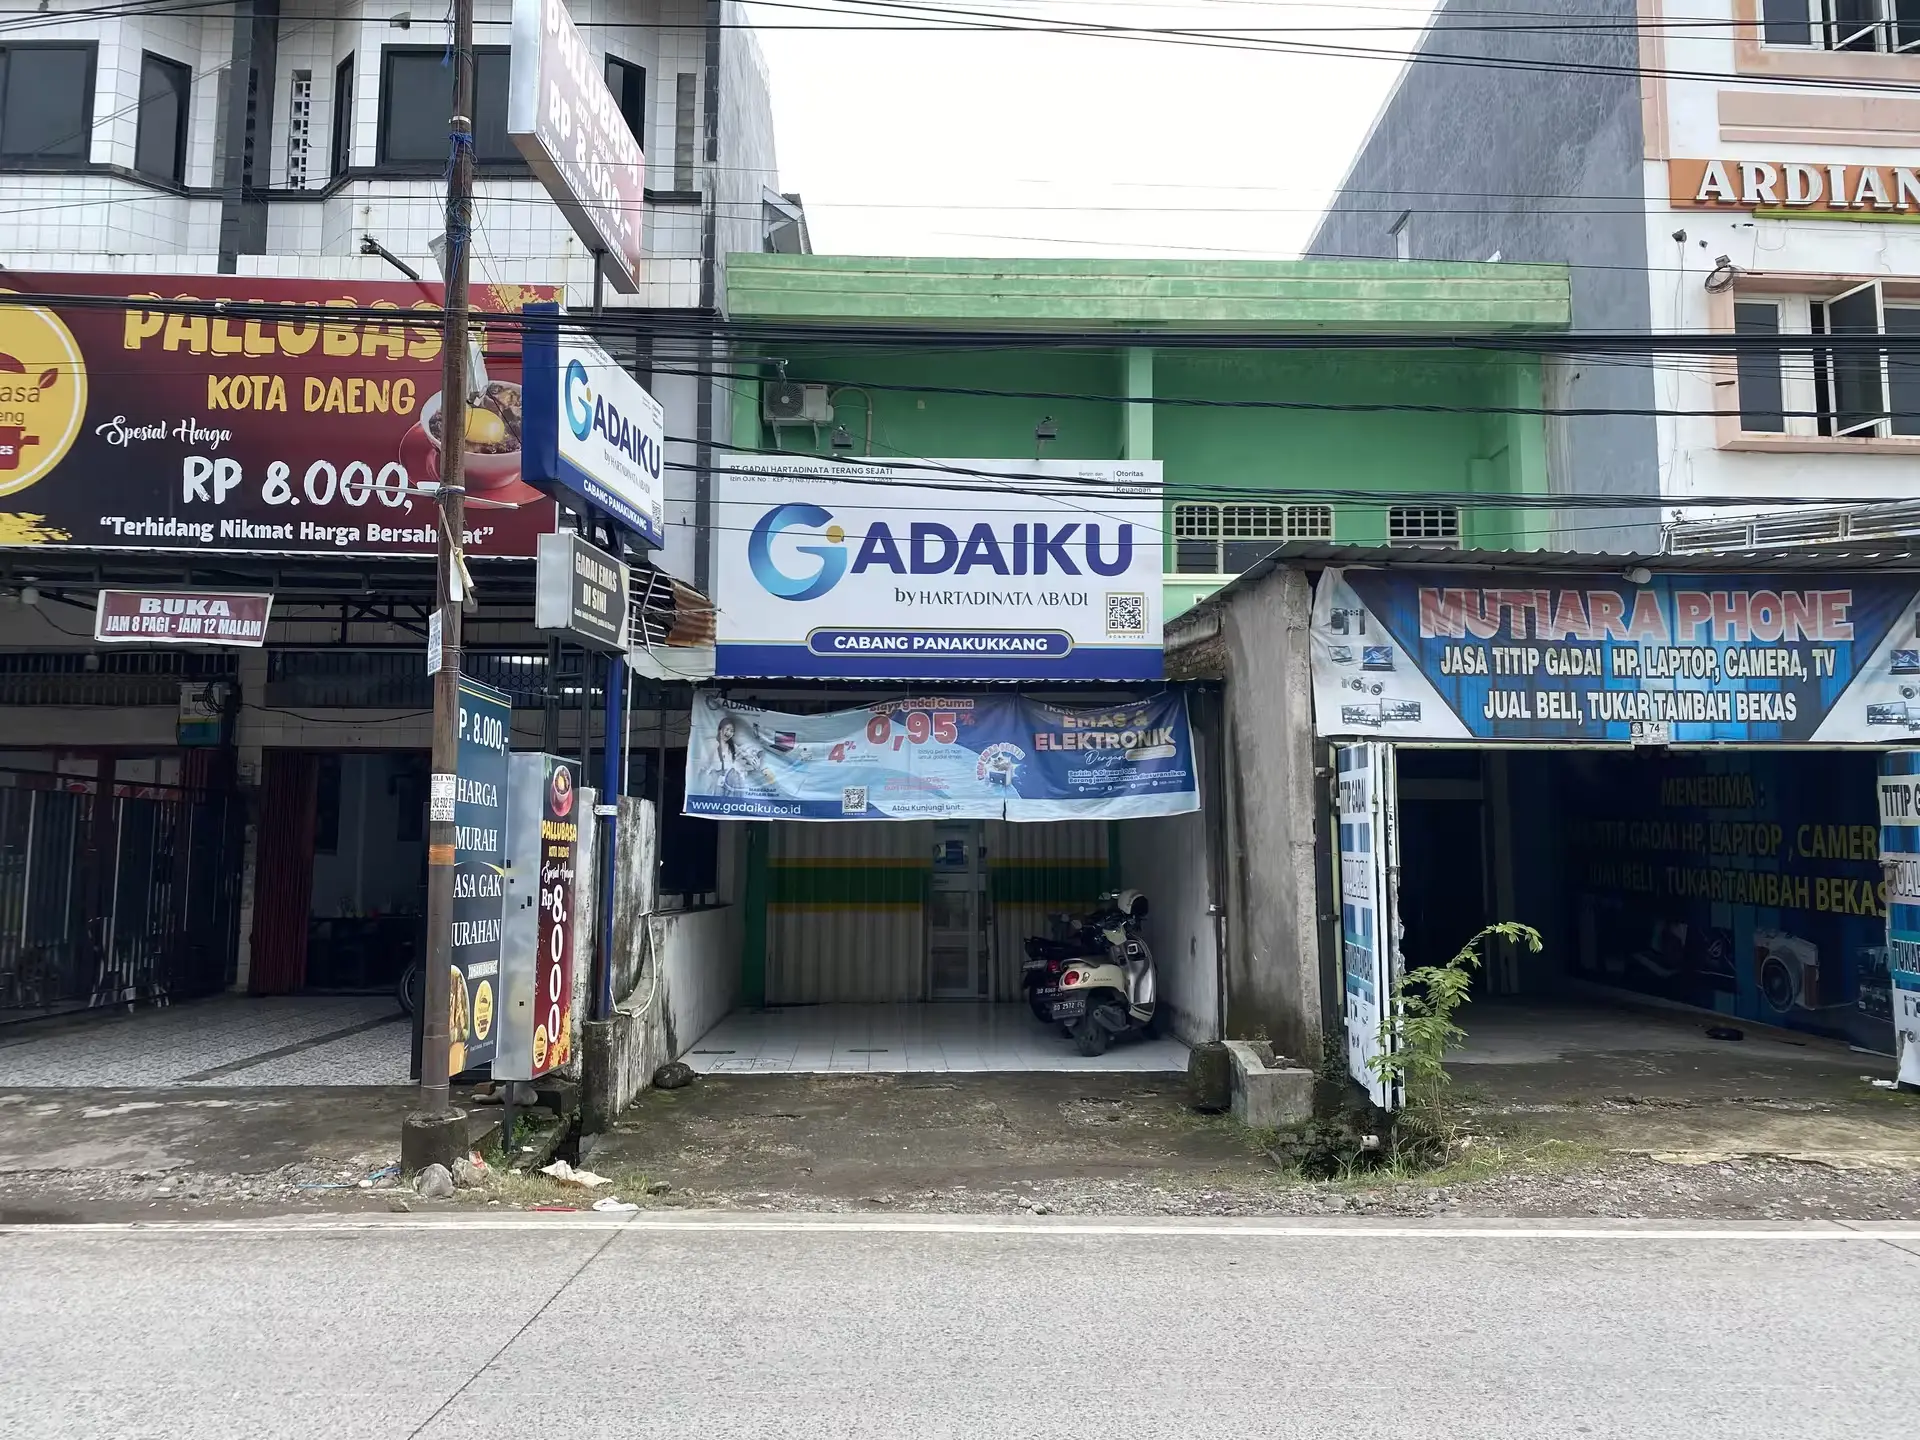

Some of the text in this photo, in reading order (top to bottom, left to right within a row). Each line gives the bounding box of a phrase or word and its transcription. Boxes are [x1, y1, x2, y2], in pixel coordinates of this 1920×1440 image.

[1695, 160, 1920, 209] ARDIAN
[208, 374, 416, 415] KOTA DAENG
[95, 415, 232, 450] Spesial Harga
[564, 359, 660, 480] GADAIKU
[742, 465, 769, 473] GADAI
[771, 466, 829, 474] HARTADINATA
[831, 467, 864, 475] TERANG
[865, 467, 893, 475] SEJATI
[183, 455, 441, 516] RP 8.000,-
[583, 479, 608, 505] CABANG
[220, 519, 293, 540] Nikmat
[300, 521, 359, 545] Harga
[367, 523, 494, 545] Bersahat”
[748, 502, 1132, 602] GADAIKU
[575, 551, 617, 592] GADAI EMAS
[139, 598, 230, 616] BUKA
[583, 582, 591, 607] DI
[894, 587, 1088, 606] by HARTADINATA ABADI
[106, 615, 130, 632] JAM
[131, 616, 139, 632] 8
[141, 616, 169, 633] PAGI
[177, 618, 200, 634] JAM
[203, 618, 216, 634] 12
[218, 619, 262, 637] MALAM
[1418, 587, 1855, 642] MUTIARA PHONE
[833, 635, 1048, 651] CABANG PANAKUKKANG
[1440, 646, 1488, 676] JASA
[1491, 647, 1540, 676] TITIP
[1544, 648, 1602, 676] GADAI
[1646, 648, 1720, 683] LAPTOP,
[1724, 648, 1808, 683] CAMERA,
[1811, 648, 1836, 676] TV
[901, 697, 937, 712] gadai
[936, 698, 974, 709] Cuma
[1484, 690, 1798, 726] JUAL BELI, TUKAR TAMBAH BEKAS
[474, 712, 509, 757] 8.000,-
[1034, 726, 1176, 751] ELEKTRONIK
[1649, 722, 1660, 732] 74
[457, 777, 498, 808] HARGA
[1662, 772, 1755, 808] MENERIMA
[1882, 785, 1911, 817] TITIP
[692, 800, 801, 814] www.gadaiku.co.id
[912, 804, 944, 812] Kunjungi
[454, 825, 498, 852] MURAH
[541, 819, 577, 842] PALLUBASA
[453, 872, 502, 899] ASA GAK
[1665, 865, 1722, 900] TUKAR
[1723, 870, 1810, 909] TAMBAH
[1815, 877, 1887, 918] BEKAS
[541, 888, 553, 911] Rp
[451, 918, 501, 947] URAHAN
